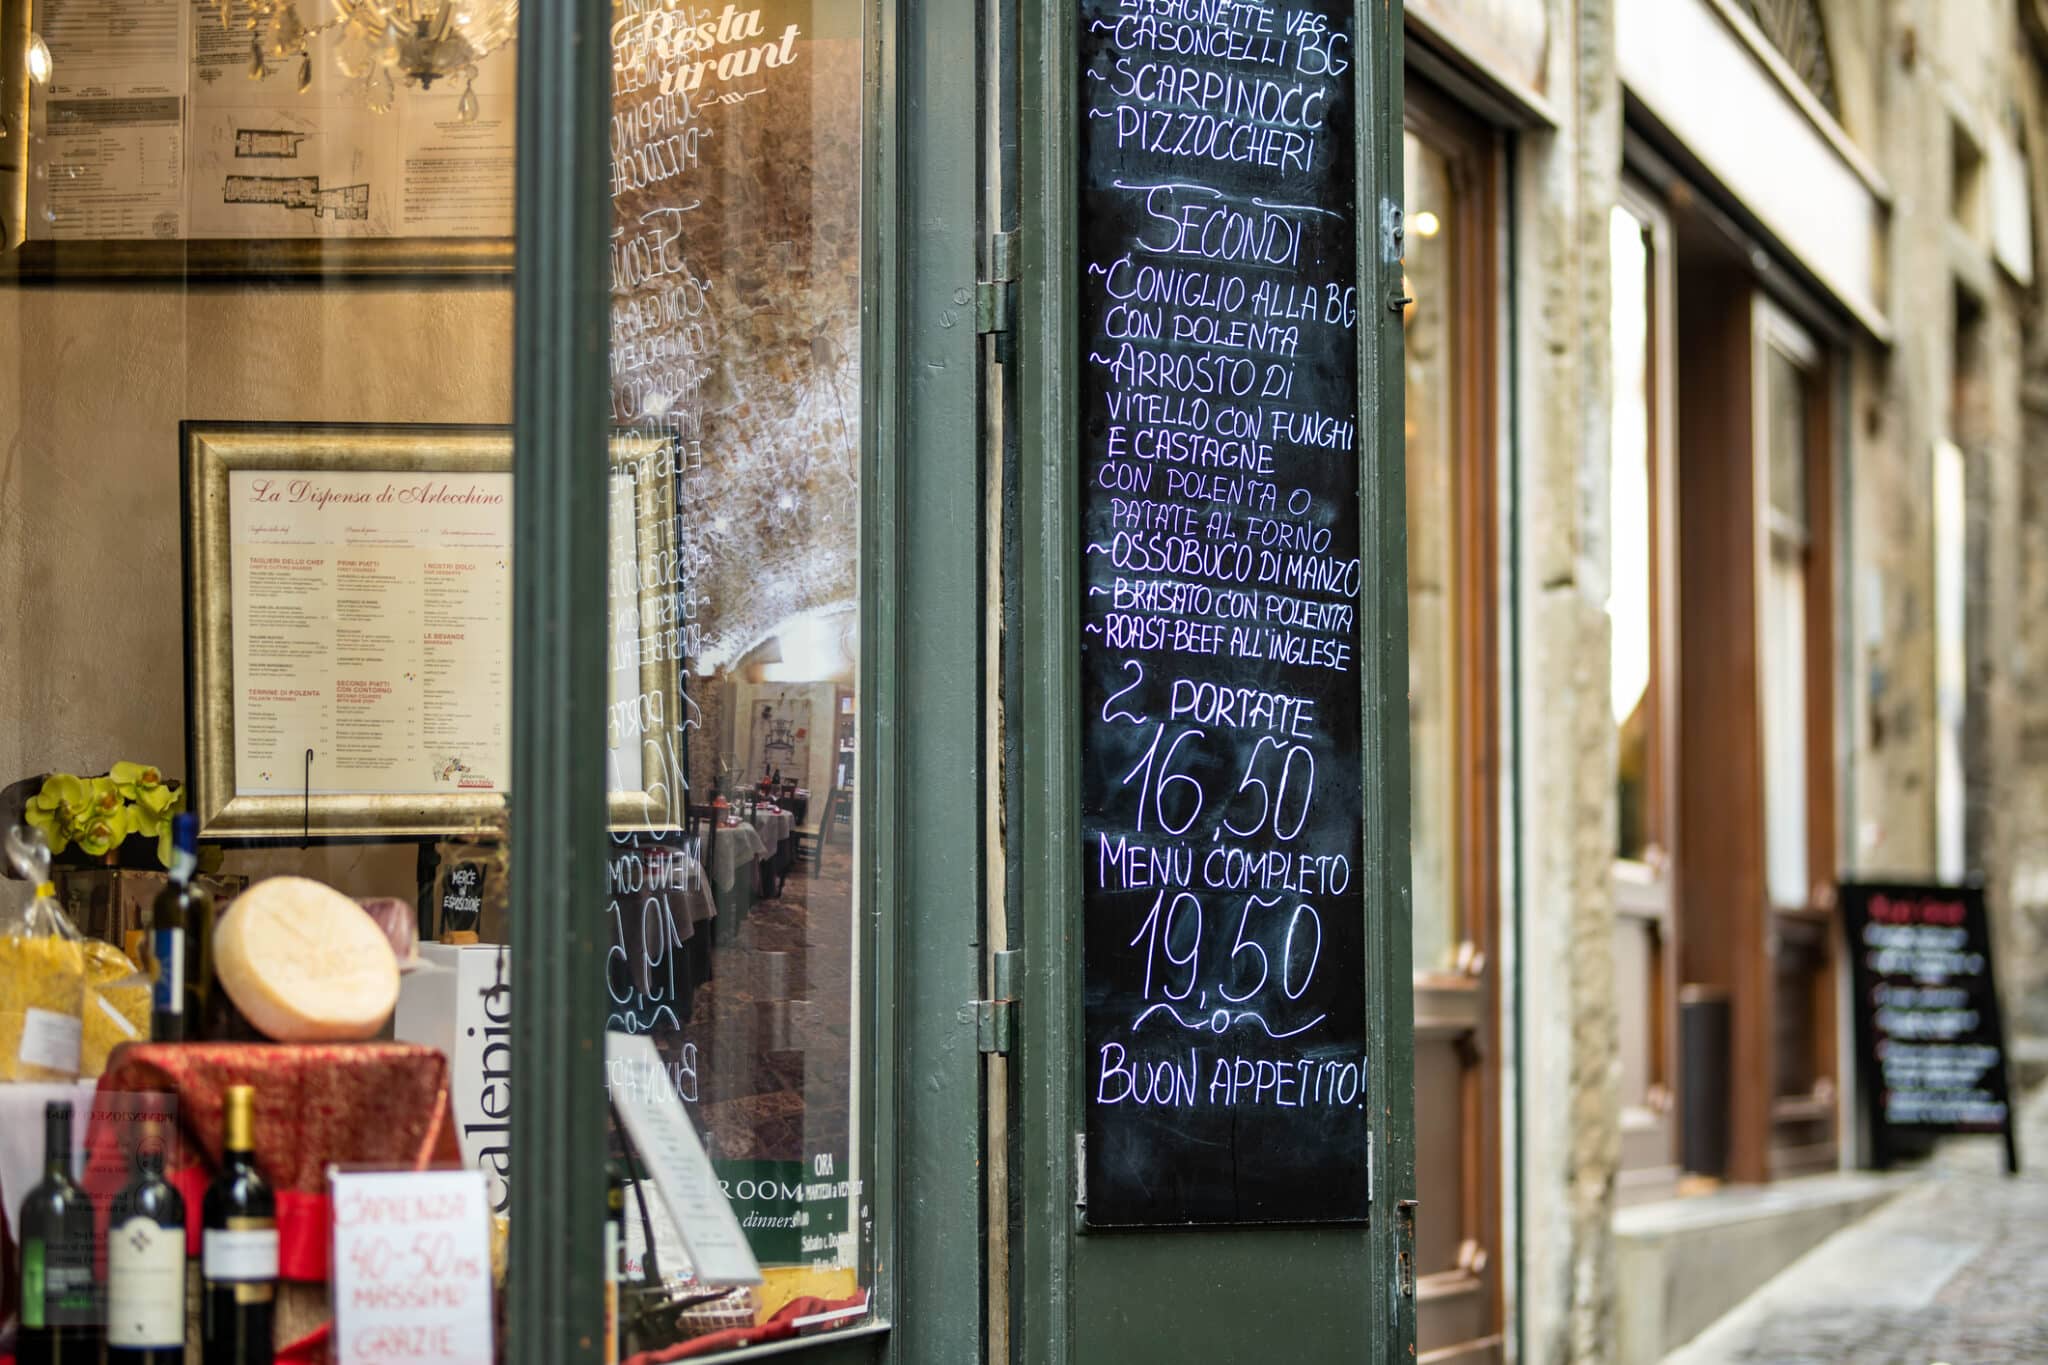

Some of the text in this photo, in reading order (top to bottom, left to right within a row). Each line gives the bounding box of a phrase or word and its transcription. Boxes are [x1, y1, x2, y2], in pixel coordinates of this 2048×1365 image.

[660, 24, 801, 95] urant
[1115, 15, 1348, 76] CASONCELLI BG
[1110, 57, 1325, 128] SCARPINOCC
[1117, 104, 1315, 178] PIZZOCCHERI
[1136, 185, 1302, 266] SECONDI
[1106, 253, 1245, 312] CONIGLIO
[1252, 280, 1317, 320] ALLA
[1106, 303, 1298, 357] CON POLENTA
[1110, 343, 1256, 395] ARROSTO
[1106, 387, 1355, 450] VITELLO CON FUNGHI
[1109, 426, 1275, 474] E CASTAGNE
[249, 478, 504, 511] La Dispensa di Arlecchino
[1099, 460, 1311, 515] CON POLENTA O
[1112, 498, 1332, 553] PATATE AL FORNO
[1111, 530, 1252, 582] OSSOBUCO
[1285, 554, 1361, 598] MANZO
[1106, 613, 1225, 654] ROAST-BEEF
[1114, 577, 1353, 633] BRASATO CON POLENTA
[1102, 659, 1314, 739] 2 PORTATE
[1123, 722, 1314, 842] 16,50
[1204, 846, 1349, 895] COMPLETO
[1130, 889, 1321, 1010] 19,50
[1097, 1042, 1368, 1110] BUON APPETITO!
